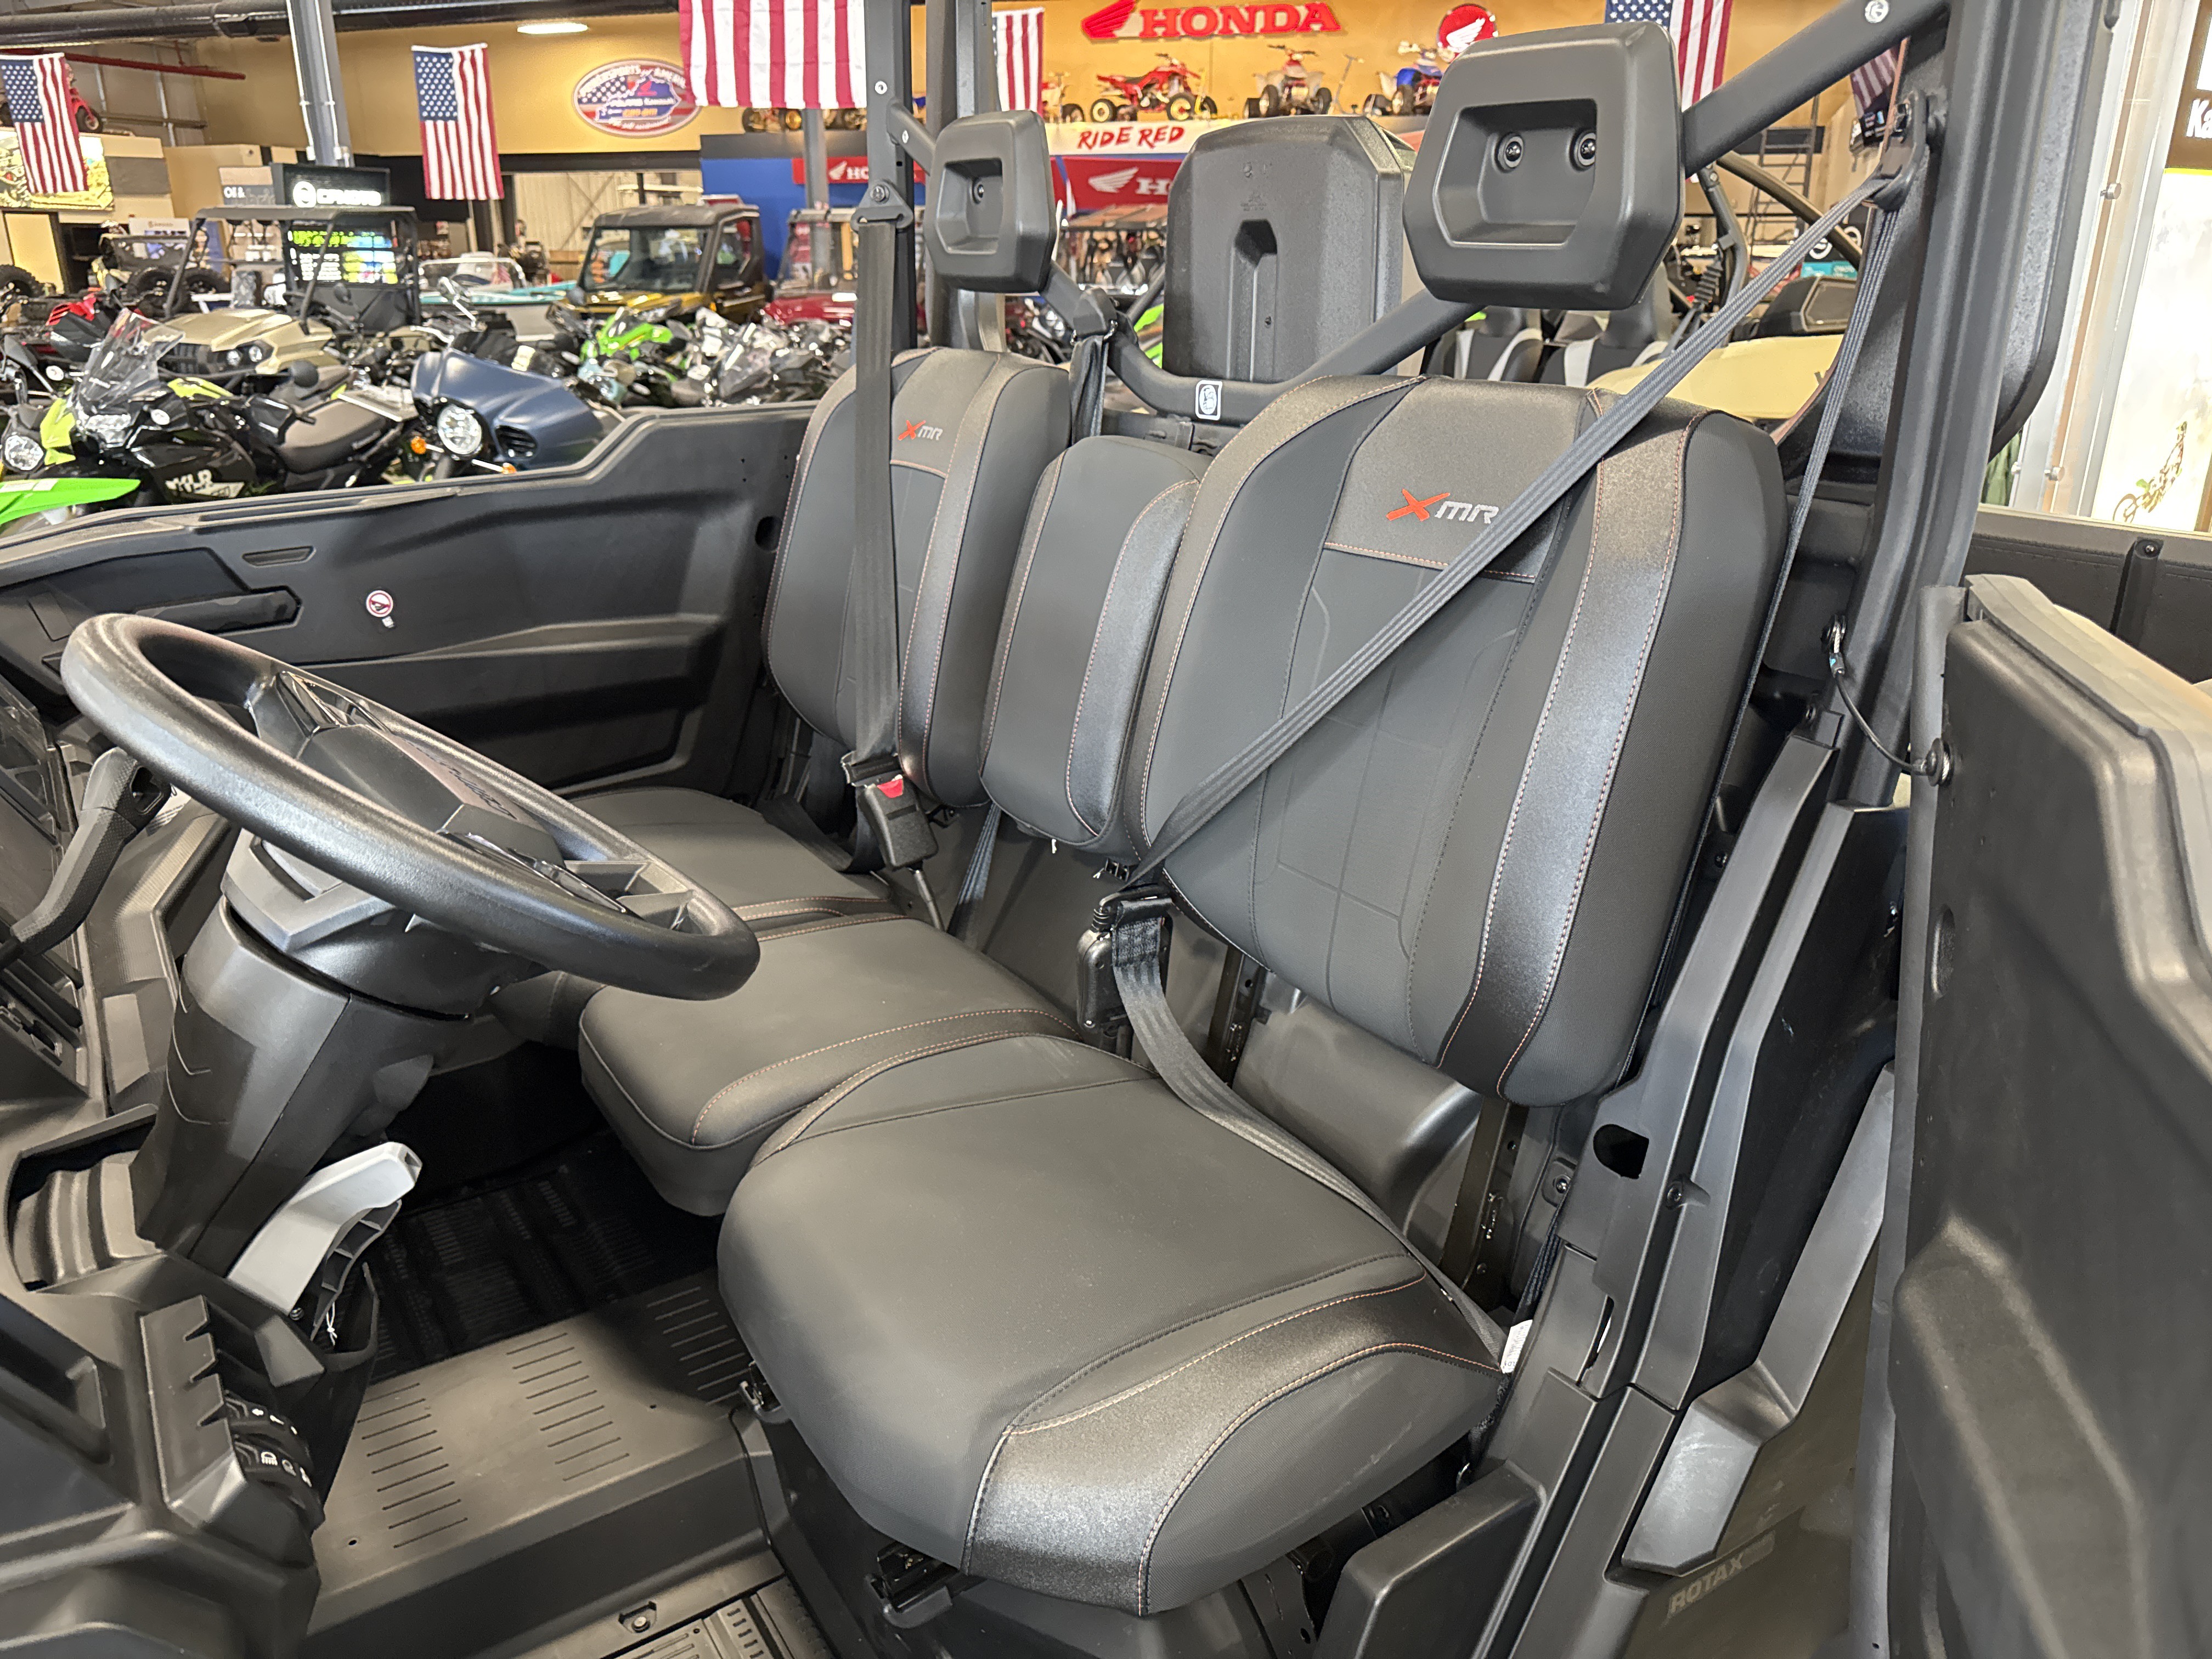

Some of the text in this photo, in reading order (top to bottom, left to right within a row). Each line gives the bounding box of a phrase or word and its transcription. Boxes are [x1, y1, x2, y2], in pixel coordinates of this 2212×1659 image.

[1139, 2, 1342, 38] HONDA
[1077, 126, 1185, 150] RIDE RED
[1671, 1553, 1744, 1614] ROTAX
